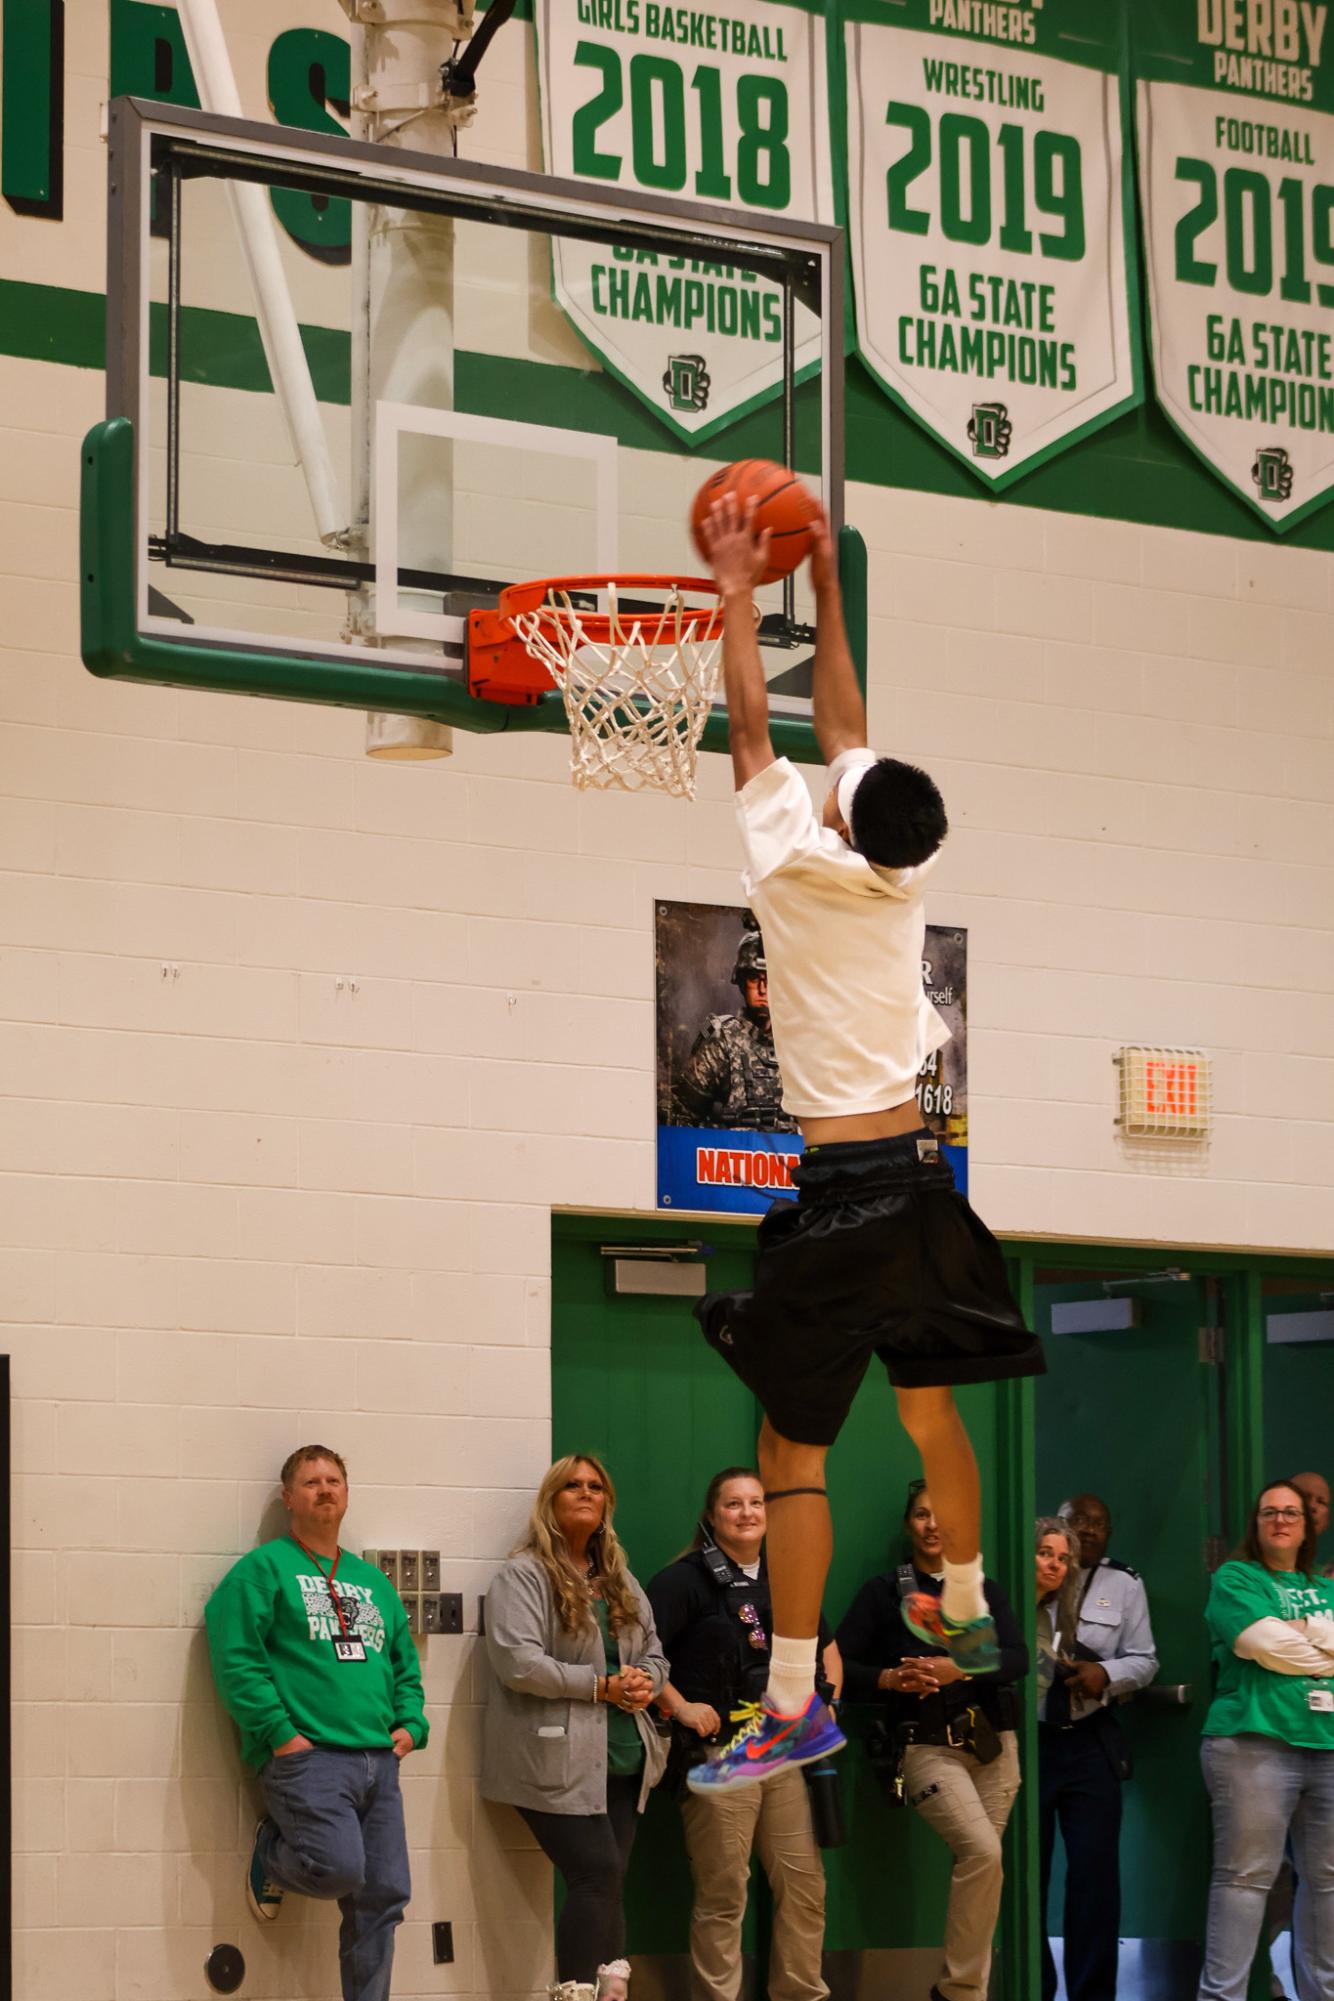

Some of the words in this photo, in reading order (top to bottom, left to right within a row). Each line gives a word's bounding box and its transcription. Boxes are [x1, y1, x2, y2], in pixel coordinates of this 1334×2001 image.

[578, 0, 639, 35] GIRLS
[645, 3, 788, 62] BASKETBALL
[929, 0, 1036, 44] PANTHERS
[1197, 0, 1328, 67] DERBY
[922, 57, 1045, 113] WRESTLING
[1214, 50, 1313, 101] PANTHERS
[572, 40, 791, 210] 2018
[1215, 116, 1315, 166] FOOTBALL
[885, 100, 1086, 263] 2019
[591, 264, 782, 343] CHAMPIONS
[919, 264, 962, 318] 6A
[969, 272, 1056, 334] STATE
[898, 316, 1077, 392] CHAMPIONS
[1206, 314, 1246, 366] 6A
[1252, 322, 1332, 380] STATE
[307, 1615, 386, 1653] PANERS
